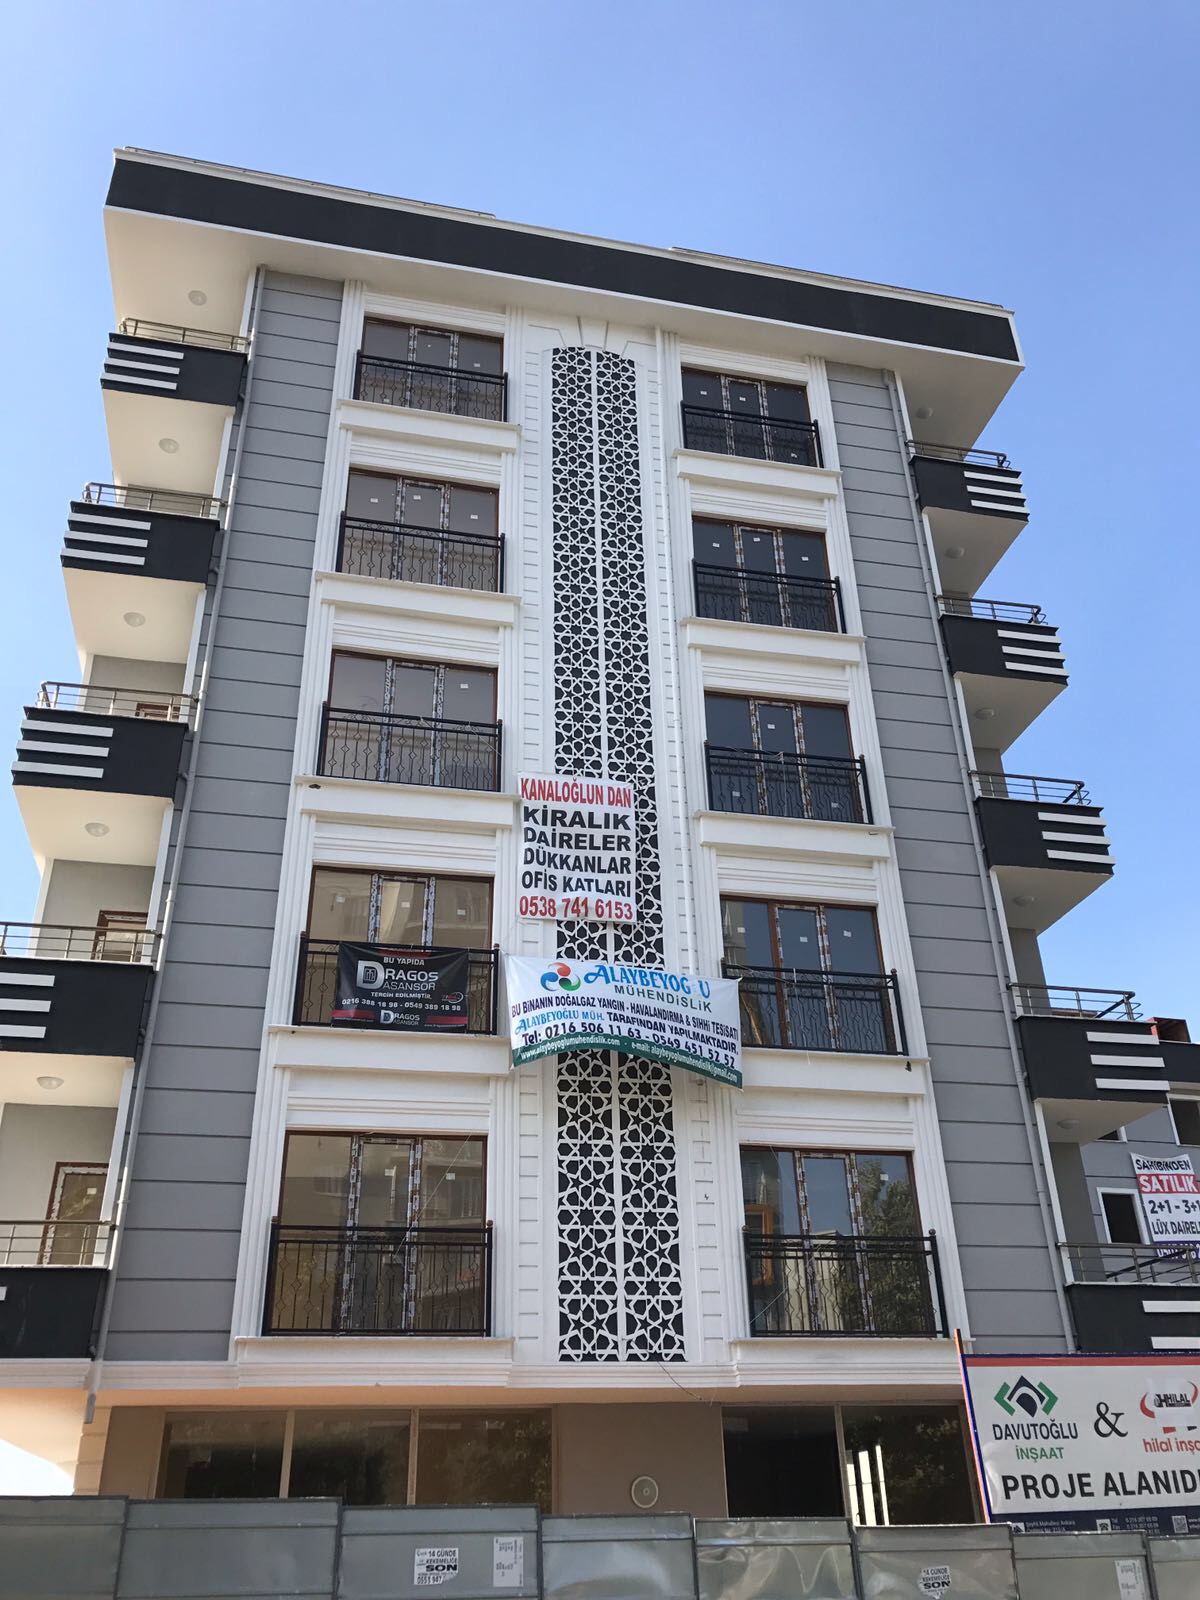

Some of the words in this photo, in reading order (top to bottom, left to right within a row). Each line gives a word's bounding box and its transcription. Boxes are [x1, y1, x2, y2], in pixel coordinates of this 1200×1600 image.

[520, 777, 604, 805] KANALOĞLUN
[607, 787, 632, 808] DAN
[523, 804, 631, 830] KİRALIK
[523, 827, 632, 852] DAİRELER
[523, 846, 632, 874] DÜKKANLAR
[521, 868, 558, 891] OFİS
[562, 876, 631, 898] KATLARI
[519, 896, 557, 918] 0538
[561, 896, 590, 917] 741
[594, 898, 634, 920] 6153
[397, 957, 425, 966] YAPIDA
[356, 960, 439, 990] DRAGOS
[512, 1003, 521, 1018] BU
[555, 994, 596, 1008] DOĞALGAZ
[597, 998, 625, 1012] YANGIN
[630, 1002, 685, 1025] HAVALANDIRMA
[685, 1015, 691, 1026] &
[514, 1008, 579, 1035] ALAYBEYOĞLU
[582, 1010, 604, 1021] MÜH.
[606, 1012, 666, 1033] TARAFINDAN
[668, 1024, 739, 1055] YAPILMAKTADIR.
[520, 1035, 620, 1060] www.alaybeyoglumuhendislik.com
[522, 1030, 542, 1046] Tel:
[545, 1022, 576, 1039] 0216
[581, 1022, 604, 1034] 506
[609, 1024, 622, 1036] 11
[628, 1028, 642, 1039] 63
[652, 1033, 681, 1049] 0549
[685, 1041, 704, 1057] 451
[708, 1049, 720, 1062] 52
[724, 1056, 735, 1070] 52
[1140, 1175, 1198, 1192] SATILIK
[1148, 1200, 1172, 1214] 2+1
[1152, 1219, 1170, 1234] LÜX
[992, 1418, 1079, 1441] DAVUTOĞLU
[1093, 1402, 1128, 1438] &
[1015, 1445, 1064, 1463] İNŞAAT
[1142, 1438, 1173, 1453] hilal
[1002, 1473, 1095, 1500] PROJE
[1104, 1469, 1200, 1496] ALANID
[924, 1580, 950, 1589] SON
